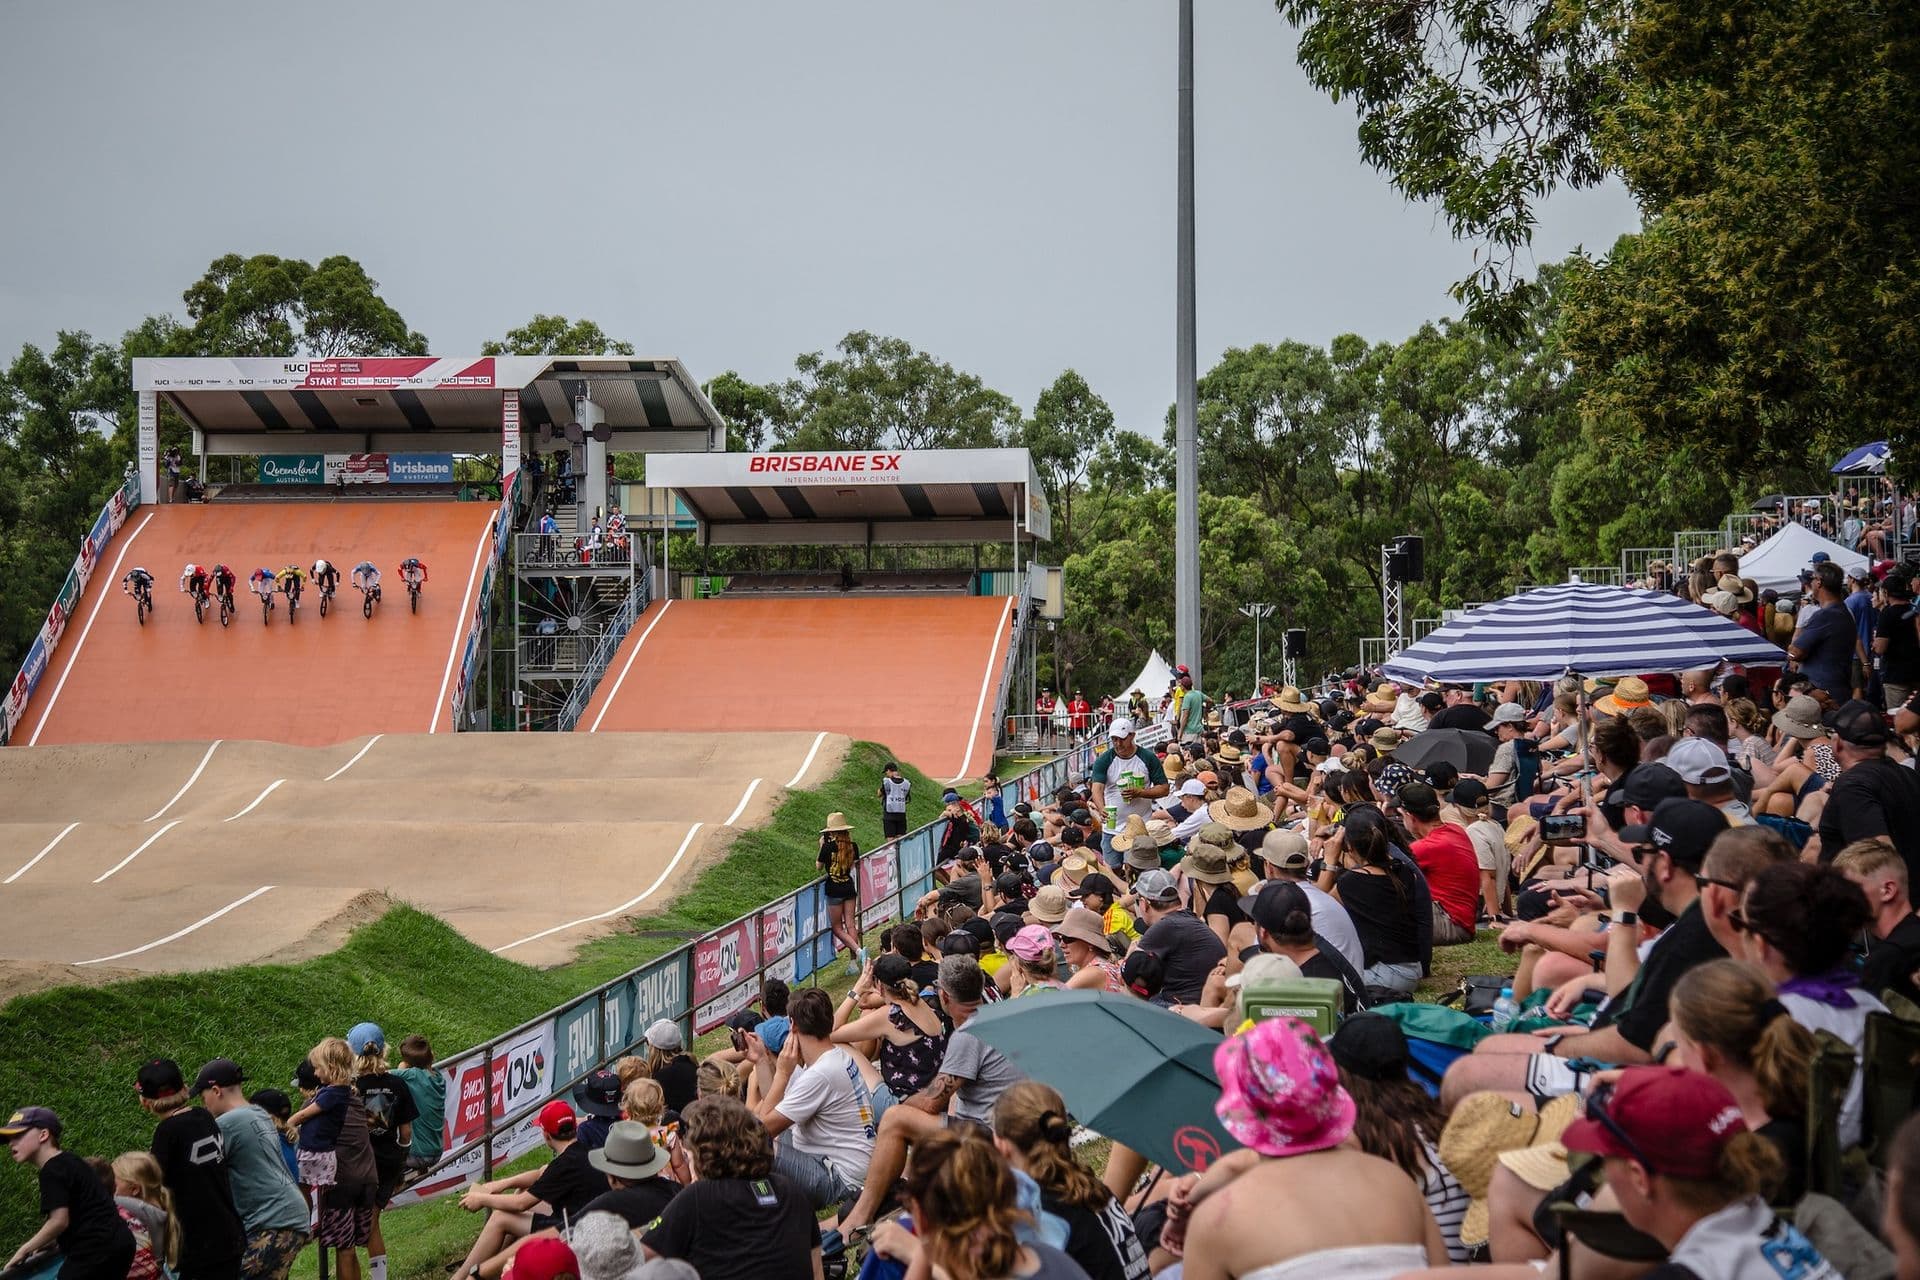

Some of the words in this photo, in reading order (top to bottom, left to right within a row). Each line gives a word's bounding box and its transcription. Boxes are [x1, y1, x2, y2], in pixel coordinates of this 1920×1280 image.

[289, 364, 308, 373] UCI
[310, 377, 337, 386] START
[330, 461, 345, 469] UCI
[393, 461, 449, 474] brisbane
[750, 455, 866, 472] BRISBANE
[870, 454, 902, 471] SX
[264, 459, 320, 477] Queensland
[785, 476, 846, 484] INTERNATIONAL
[870, 475, 900, 483] CENTRE
